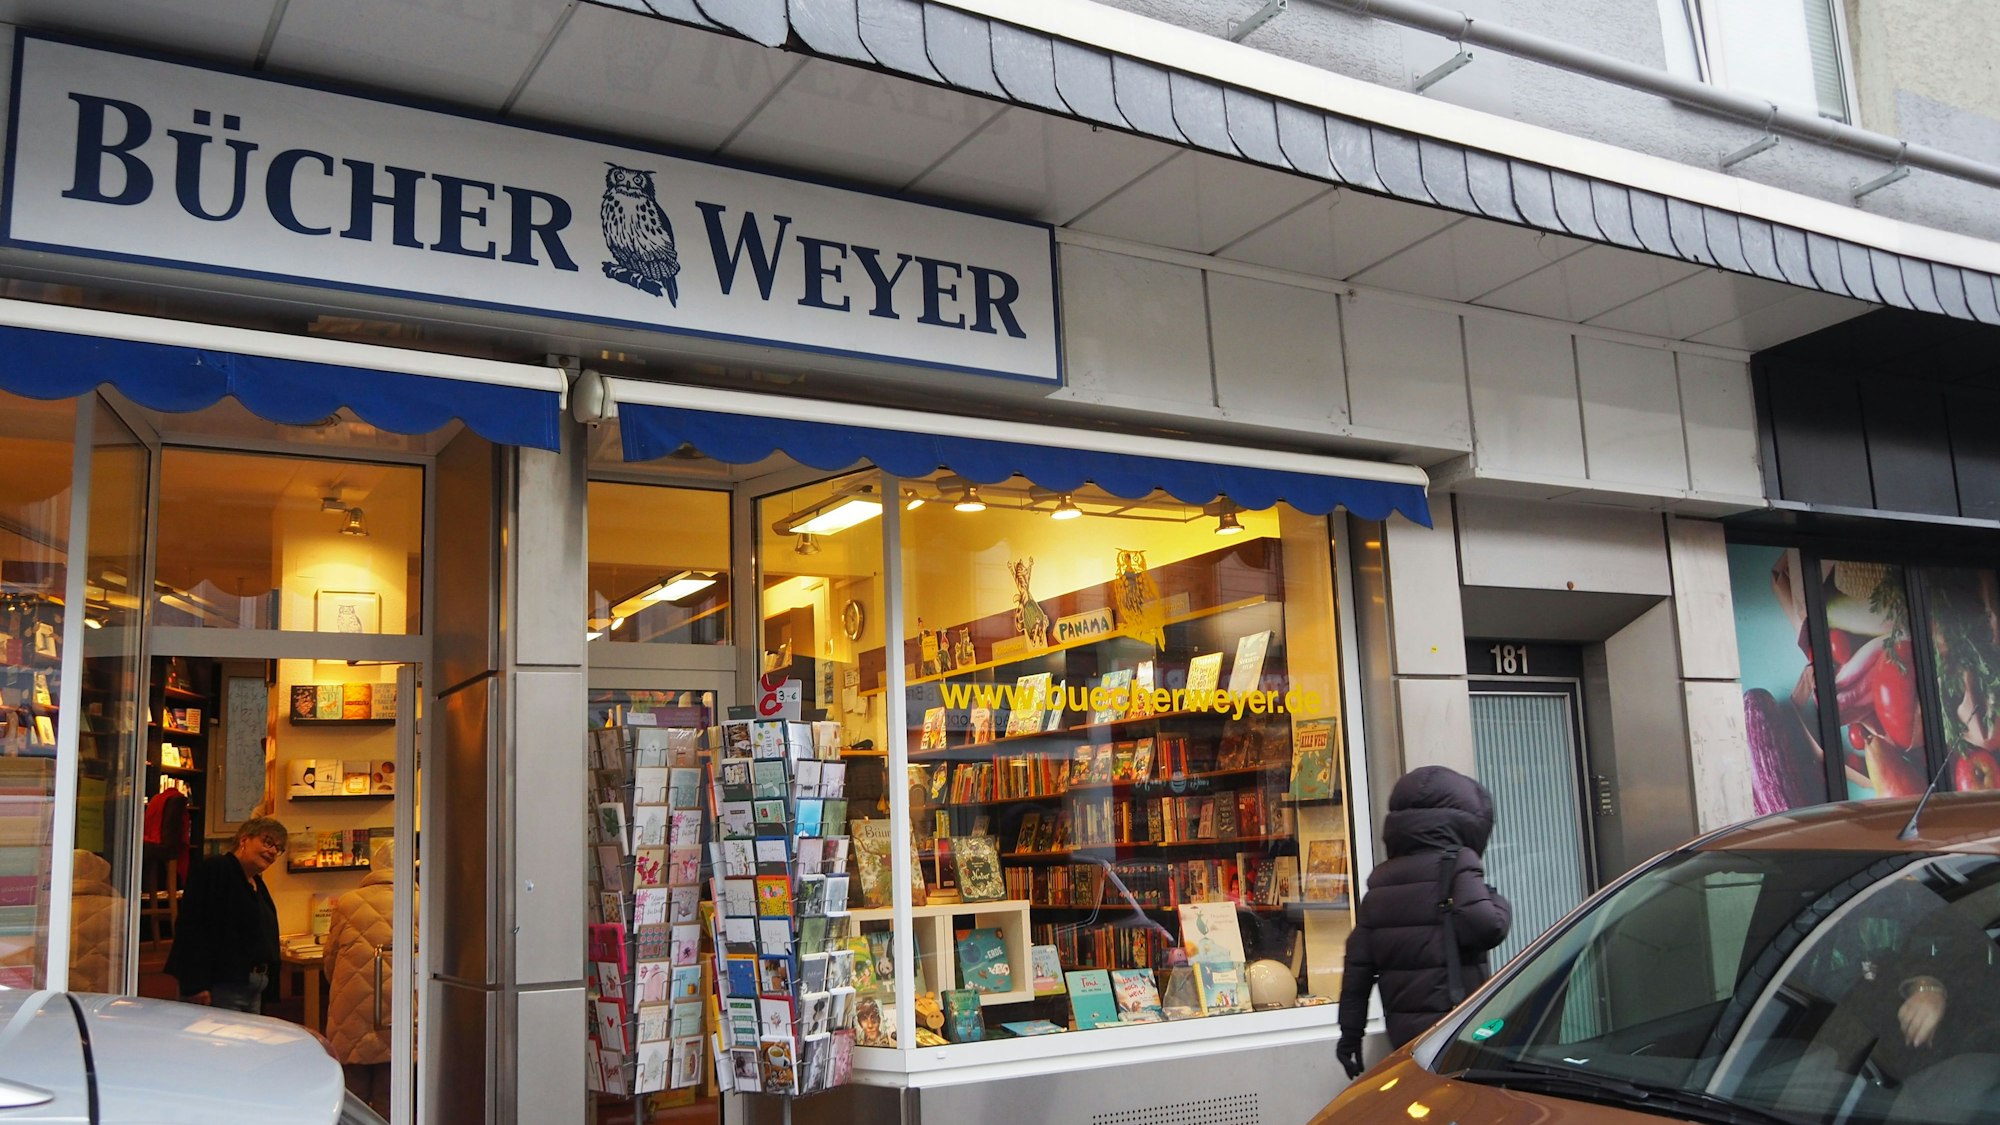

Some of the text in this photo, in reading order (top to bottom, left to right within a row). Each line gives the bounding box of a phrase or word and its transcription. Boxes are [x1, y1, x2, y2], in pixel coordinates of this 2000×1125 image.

[61, 91, 1027, 339] BÜCHER WEYER
[1058, 616, 1110, 641] PANAMA
[1490, 644, 1528, 674] 181
[940, 679, 1322, 721] www.buecherweyer.de
[1081, 976, 1099, 988] Toni
